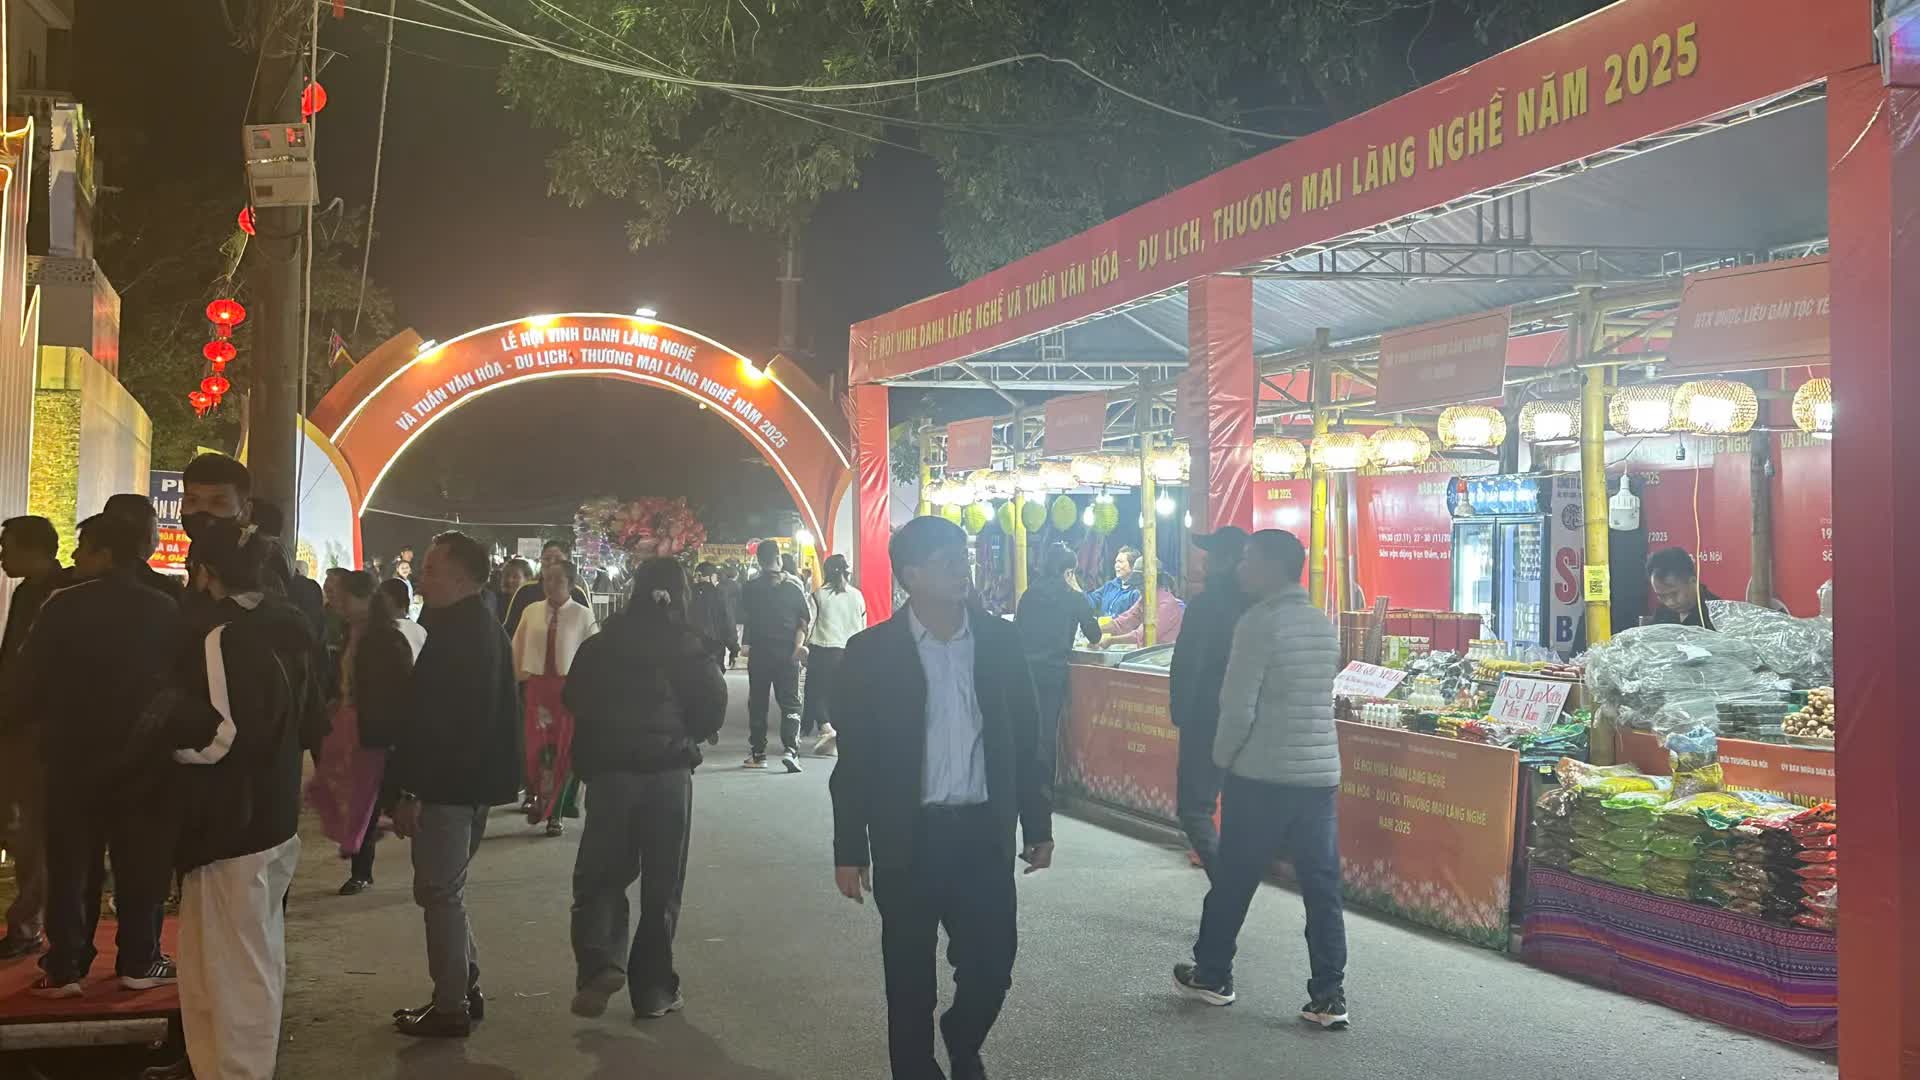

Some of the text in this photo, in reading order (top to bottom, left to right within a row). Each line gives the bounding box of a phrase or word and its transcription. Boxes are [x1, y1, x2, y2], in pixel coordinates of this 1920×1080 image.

[896, 326, 917, 353] VINH
[919, 317, 945, 347] DANH
[1091, 248, 1119, 289] HÓA
[1138, 232, 1160, 272] DU
[1165, 217, 1206, 263] LỊCH,
[1213, 182, 1292, 244] THƯƠNG
[1300, 158, 1342, 213] MẠI
[1351, 136, 1416, 197] LÀNG
[1427, 87, 1506, 169] NGHỀ
[1516, 64, 1589, 137] NĂM
[1604, 21, 1700, 106] 2025
[547, 326, 579, 343] VINH
[583, 327, 620, 344] DANH
[622, 327, 659, 349] LÀNG
[395, 411, 417, 431] VÀ
[474, 361, 505, 382] HÓA
[514, 352, 535, 370] DU
[579, 347, 633, 367] THƯƠNG
[636, 354, 662, 375] MẠI
[664, 362, 699, 387] LÀNG
[759, 419, 789, 449] 2025
